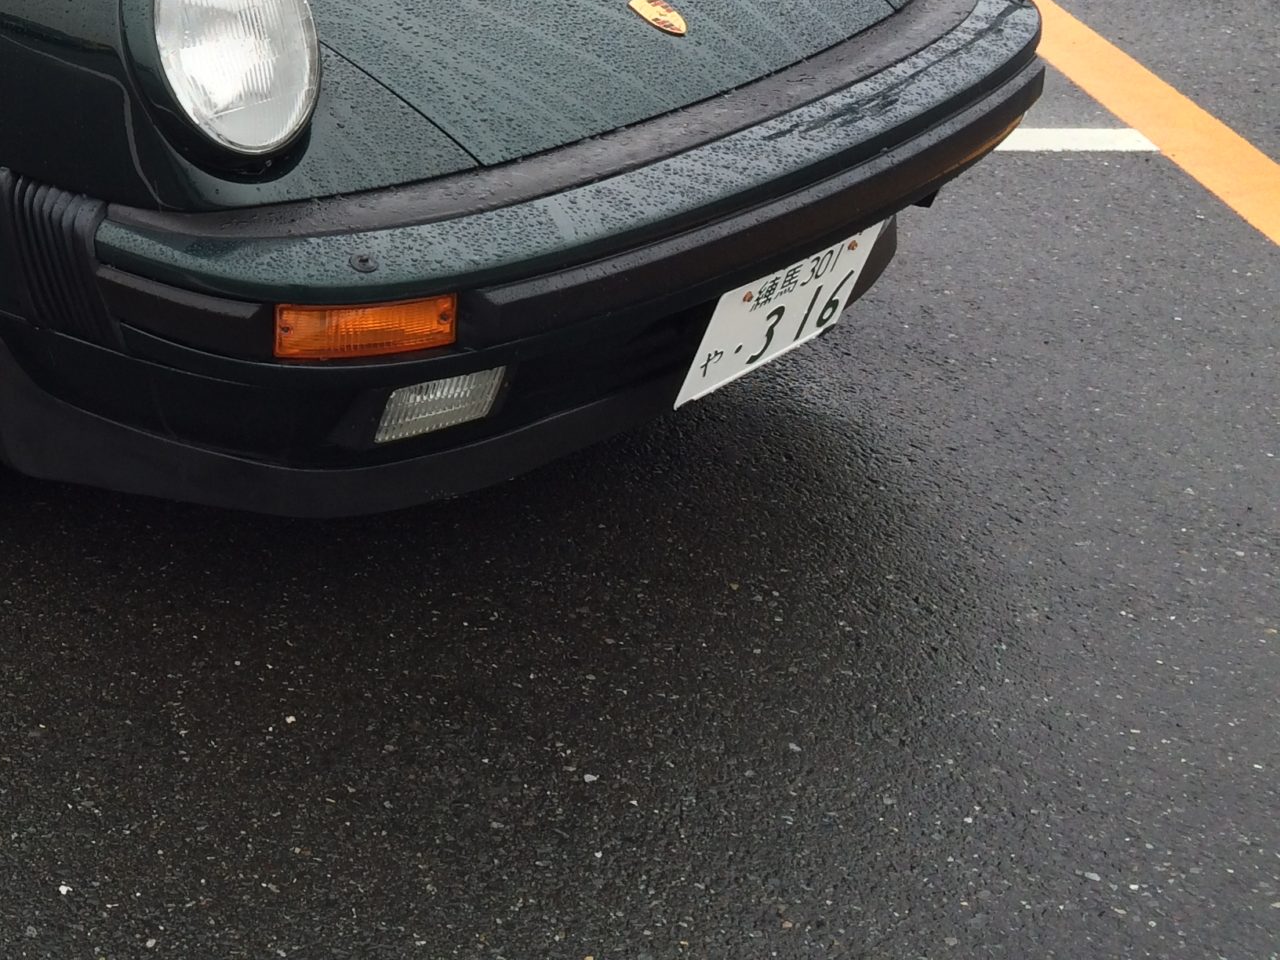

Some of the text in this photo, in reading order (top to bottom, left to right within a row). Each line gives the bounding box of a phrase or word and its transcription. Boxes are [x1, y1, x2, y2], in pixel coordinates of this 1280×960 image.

[749, 244, 845, 312] 練馬 301
[700, 349, 724, 378] や
